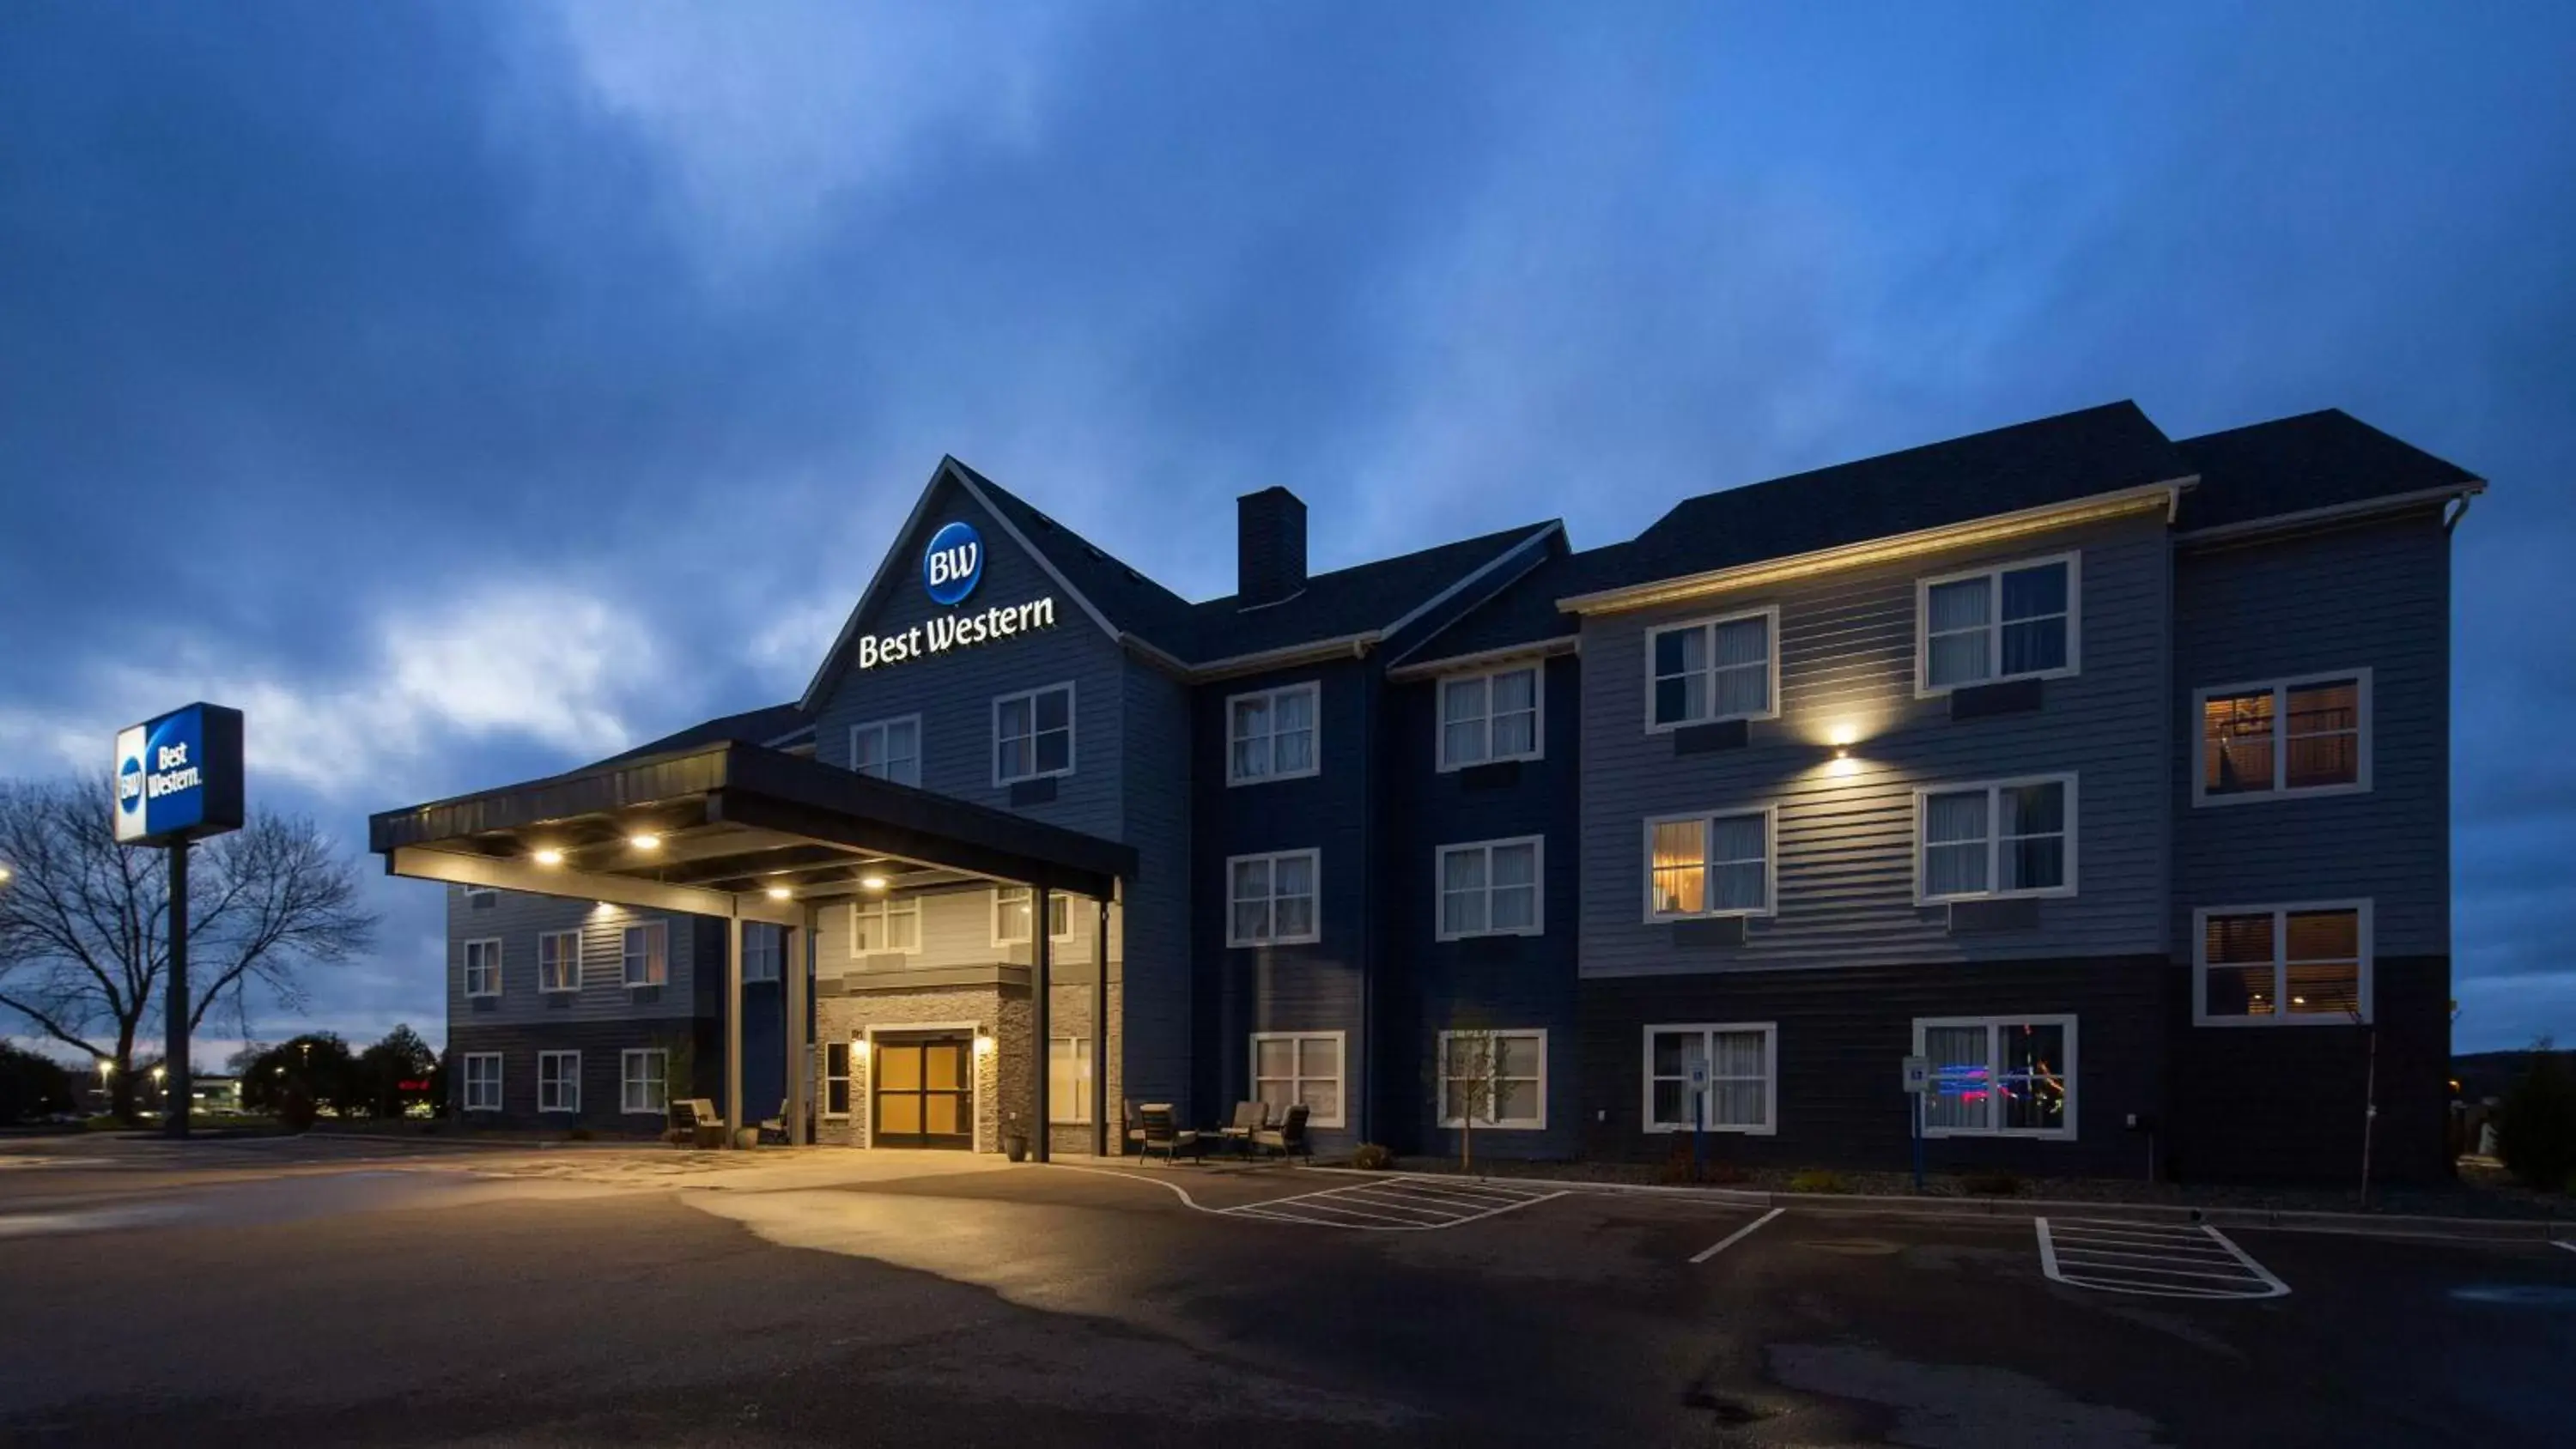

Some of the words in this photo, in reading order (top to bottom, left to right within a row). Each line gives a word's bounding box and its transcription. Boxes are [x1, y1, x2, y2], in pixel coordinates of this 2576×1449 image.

[930, 542, 976, 585] BW
[860, 627, 921, 669] Best
[927, 597, 1054, 653] Western
[159, 742, 187, 769] Best
